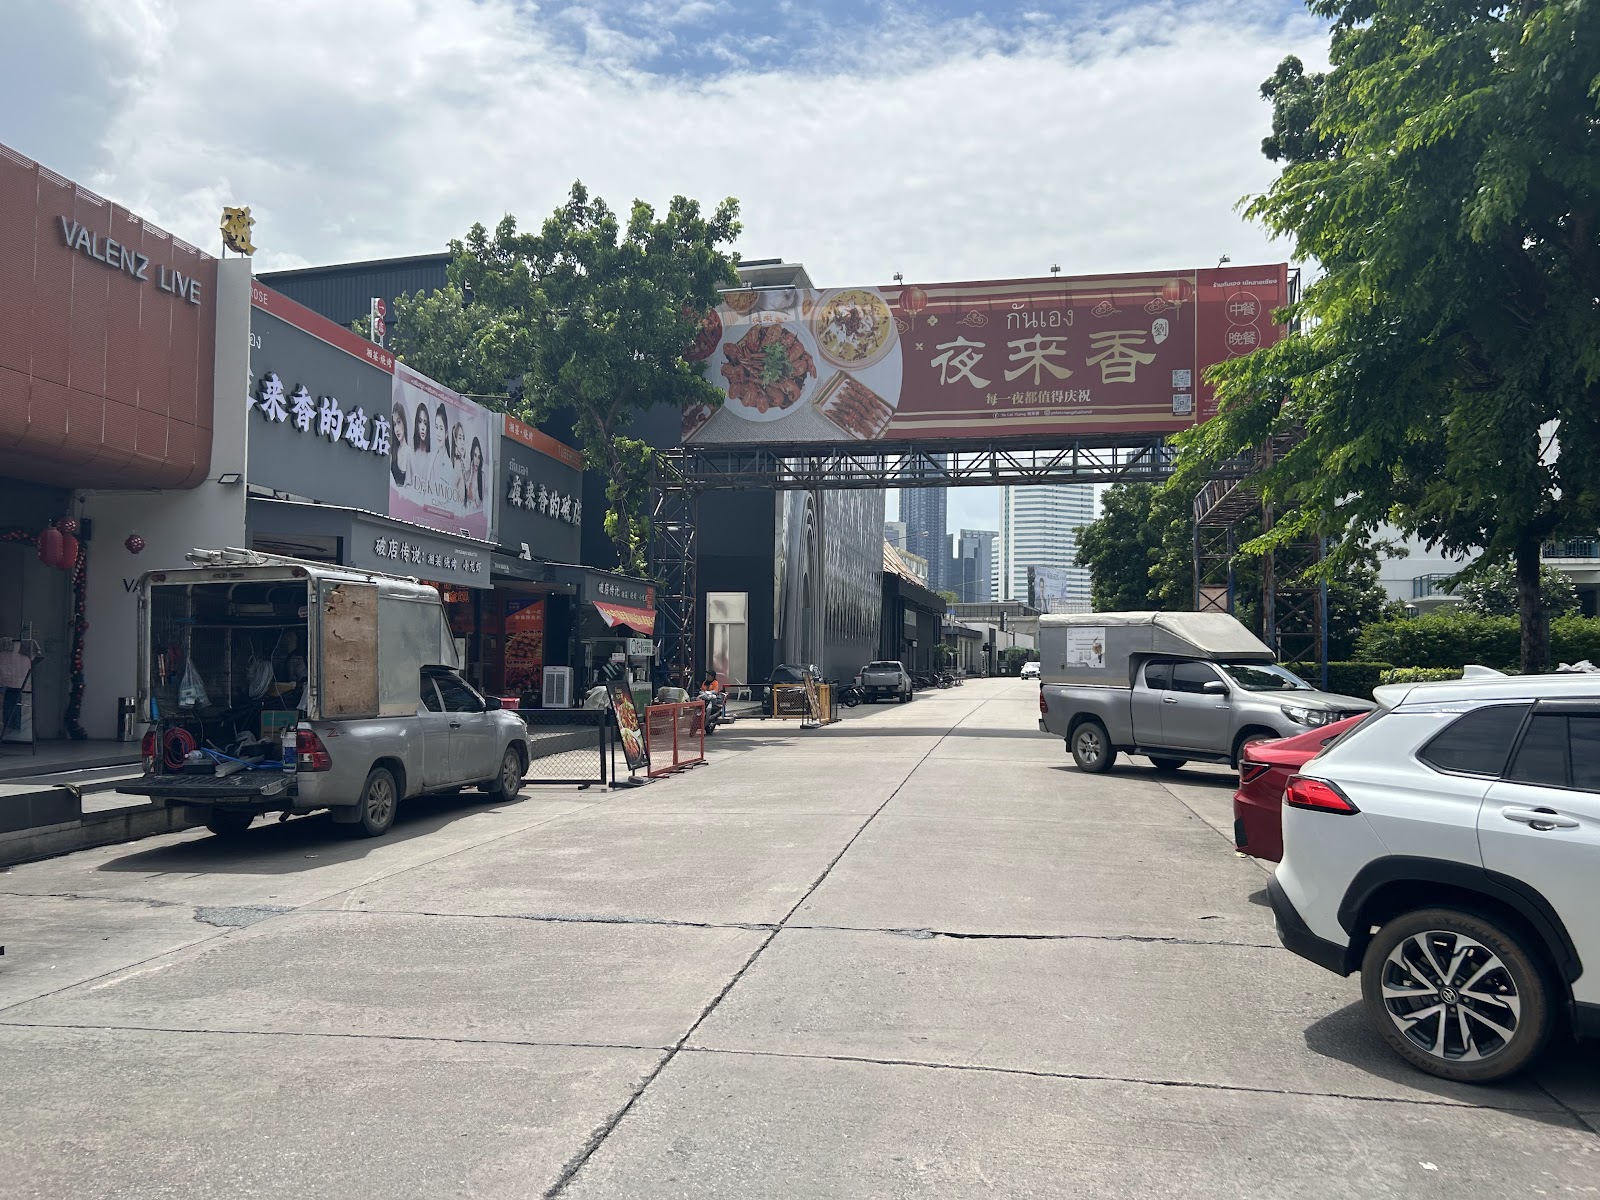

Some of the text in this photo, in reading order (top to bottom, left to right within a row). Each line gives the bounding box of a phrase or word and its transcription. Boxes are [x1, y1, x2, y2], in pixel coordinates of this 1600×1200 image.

[57, 215, 202, 306] VALENZ LIVE
[1006, 303, 1074, 330] กันเอง
[1229, 301, 1256, 317] 中餐
[1228, 331, 1256, 346] 晚餐
[930, 329, 1157, 389] 夜来香
[985, 388, 1091, 406] 每一夜都值得庆祝
[248, 369, 391, 456] 来香的破店
